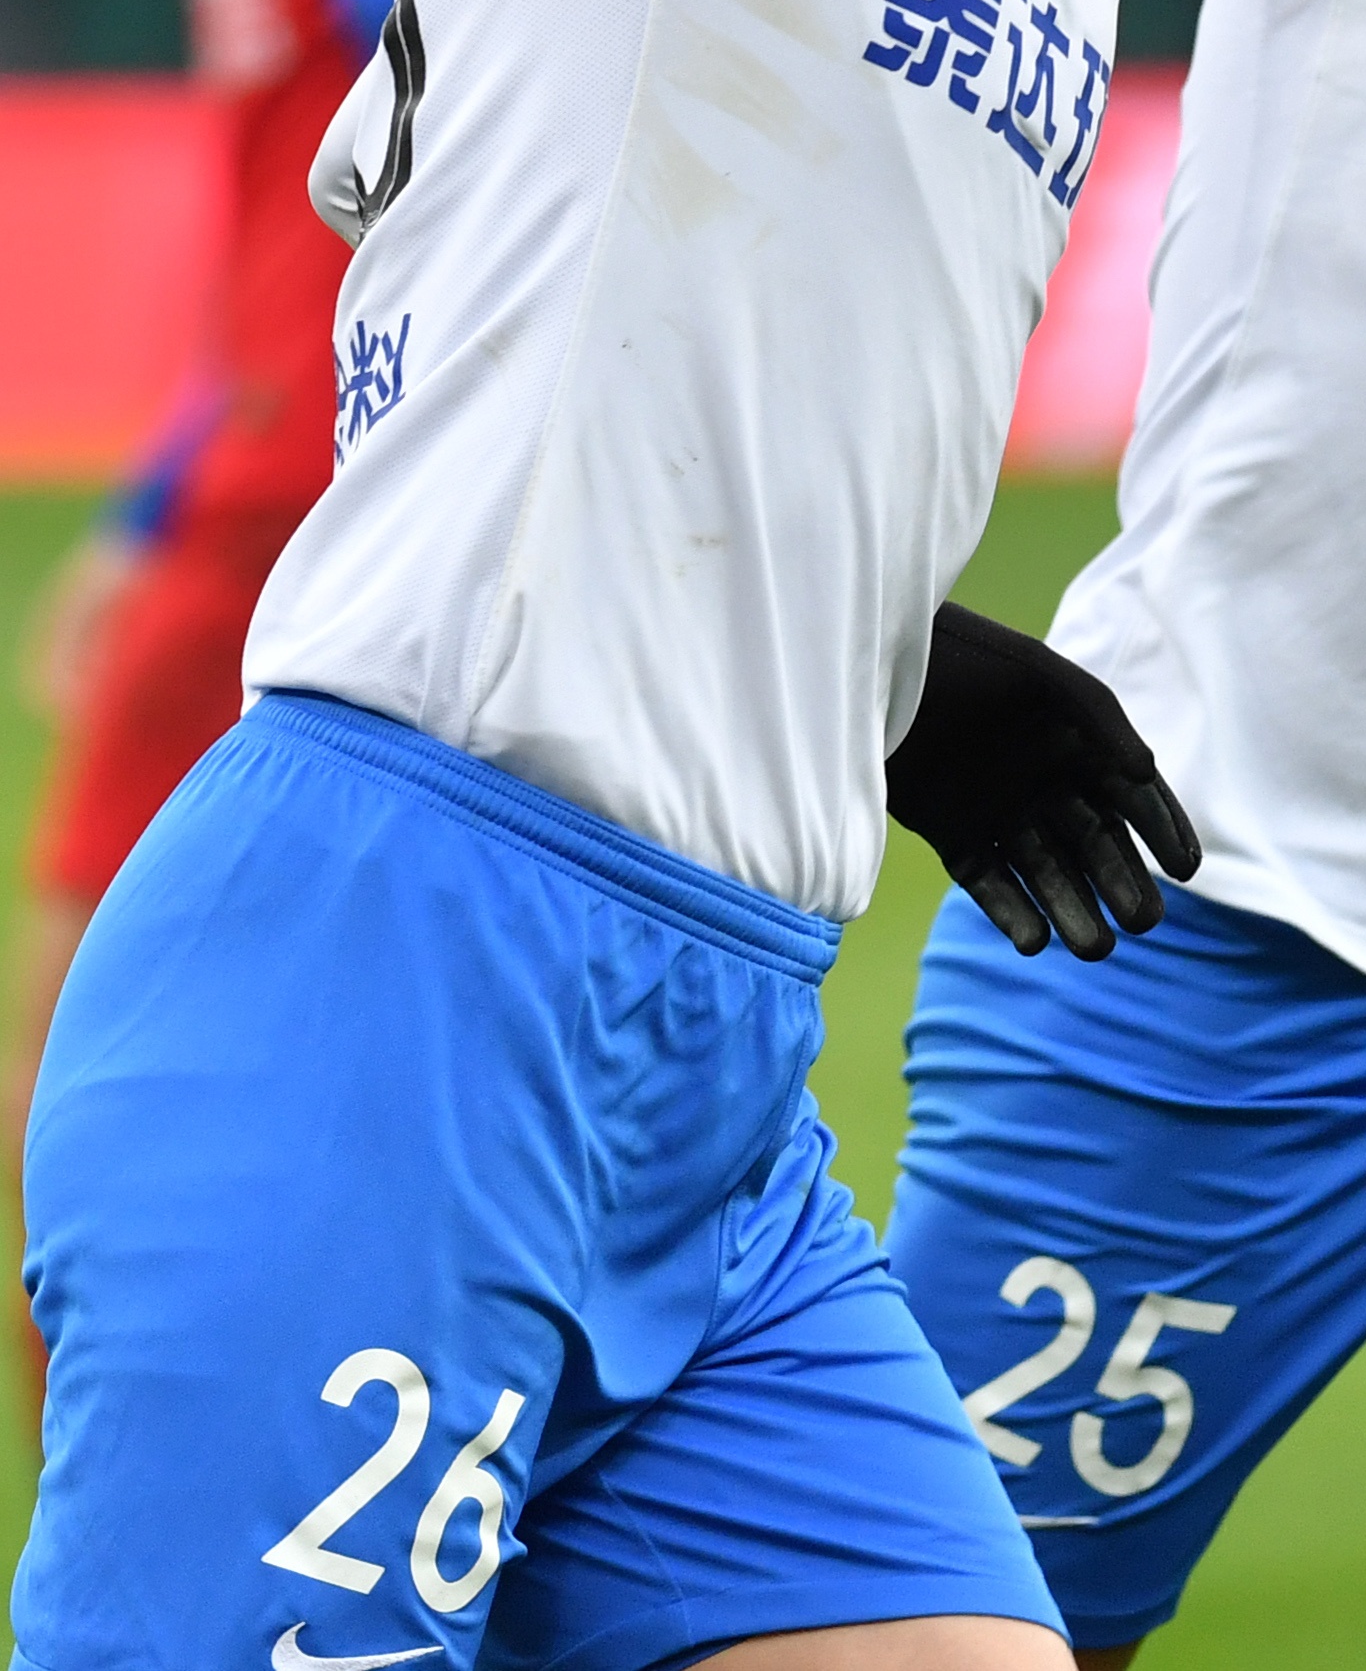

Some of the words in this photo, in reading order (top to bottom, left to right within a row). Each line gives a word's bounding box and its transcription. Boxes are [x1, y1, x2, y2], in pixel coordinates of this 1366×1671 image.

[332, 313, 412, 466] 料
[261, 1347, 526, 1613] 26
[963, 1255, 1238, 1498] 25
